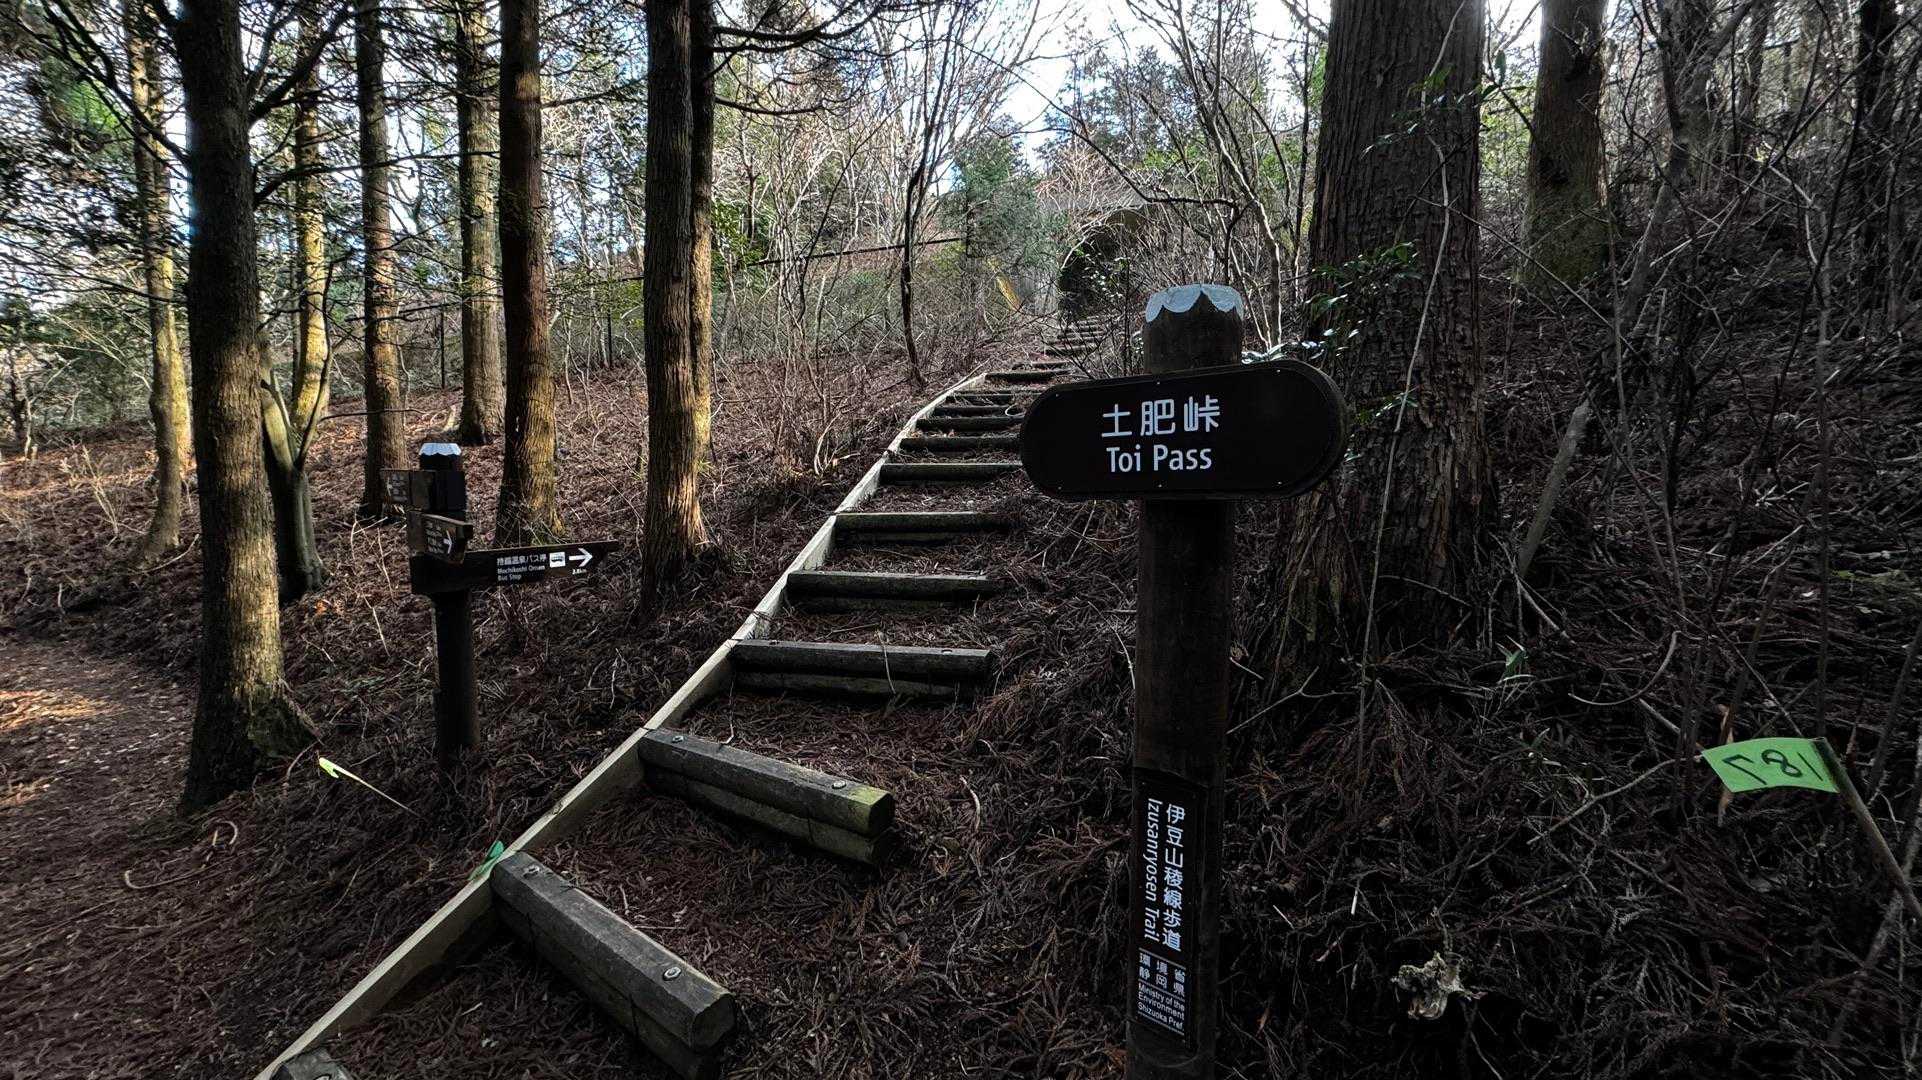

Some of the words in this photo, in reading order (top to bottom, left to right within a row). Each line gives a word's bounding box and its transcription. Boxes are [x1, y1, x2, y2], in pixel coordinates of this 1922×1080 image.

[1101, 394, 1220, 438] 土肥峠
[1106, 444, 1141, 473] Toi
[1153, 444, 1212, 471] Pass
[1142, 798, 1163, 902] Izusanryosen
[1162, 803, 1186, 952] 伊豆山稜線歩道
[1144, 907, 1160, 942] Trail
[1138, 982, 1165, 1003] Ministry
[1165, 996, 1173, 1005] of
[1173, 998, 1185, 1012] the
[1138, 991, 1185, 1021] Environment
[1138, 1001, 1168, 1023] Shizuoka
